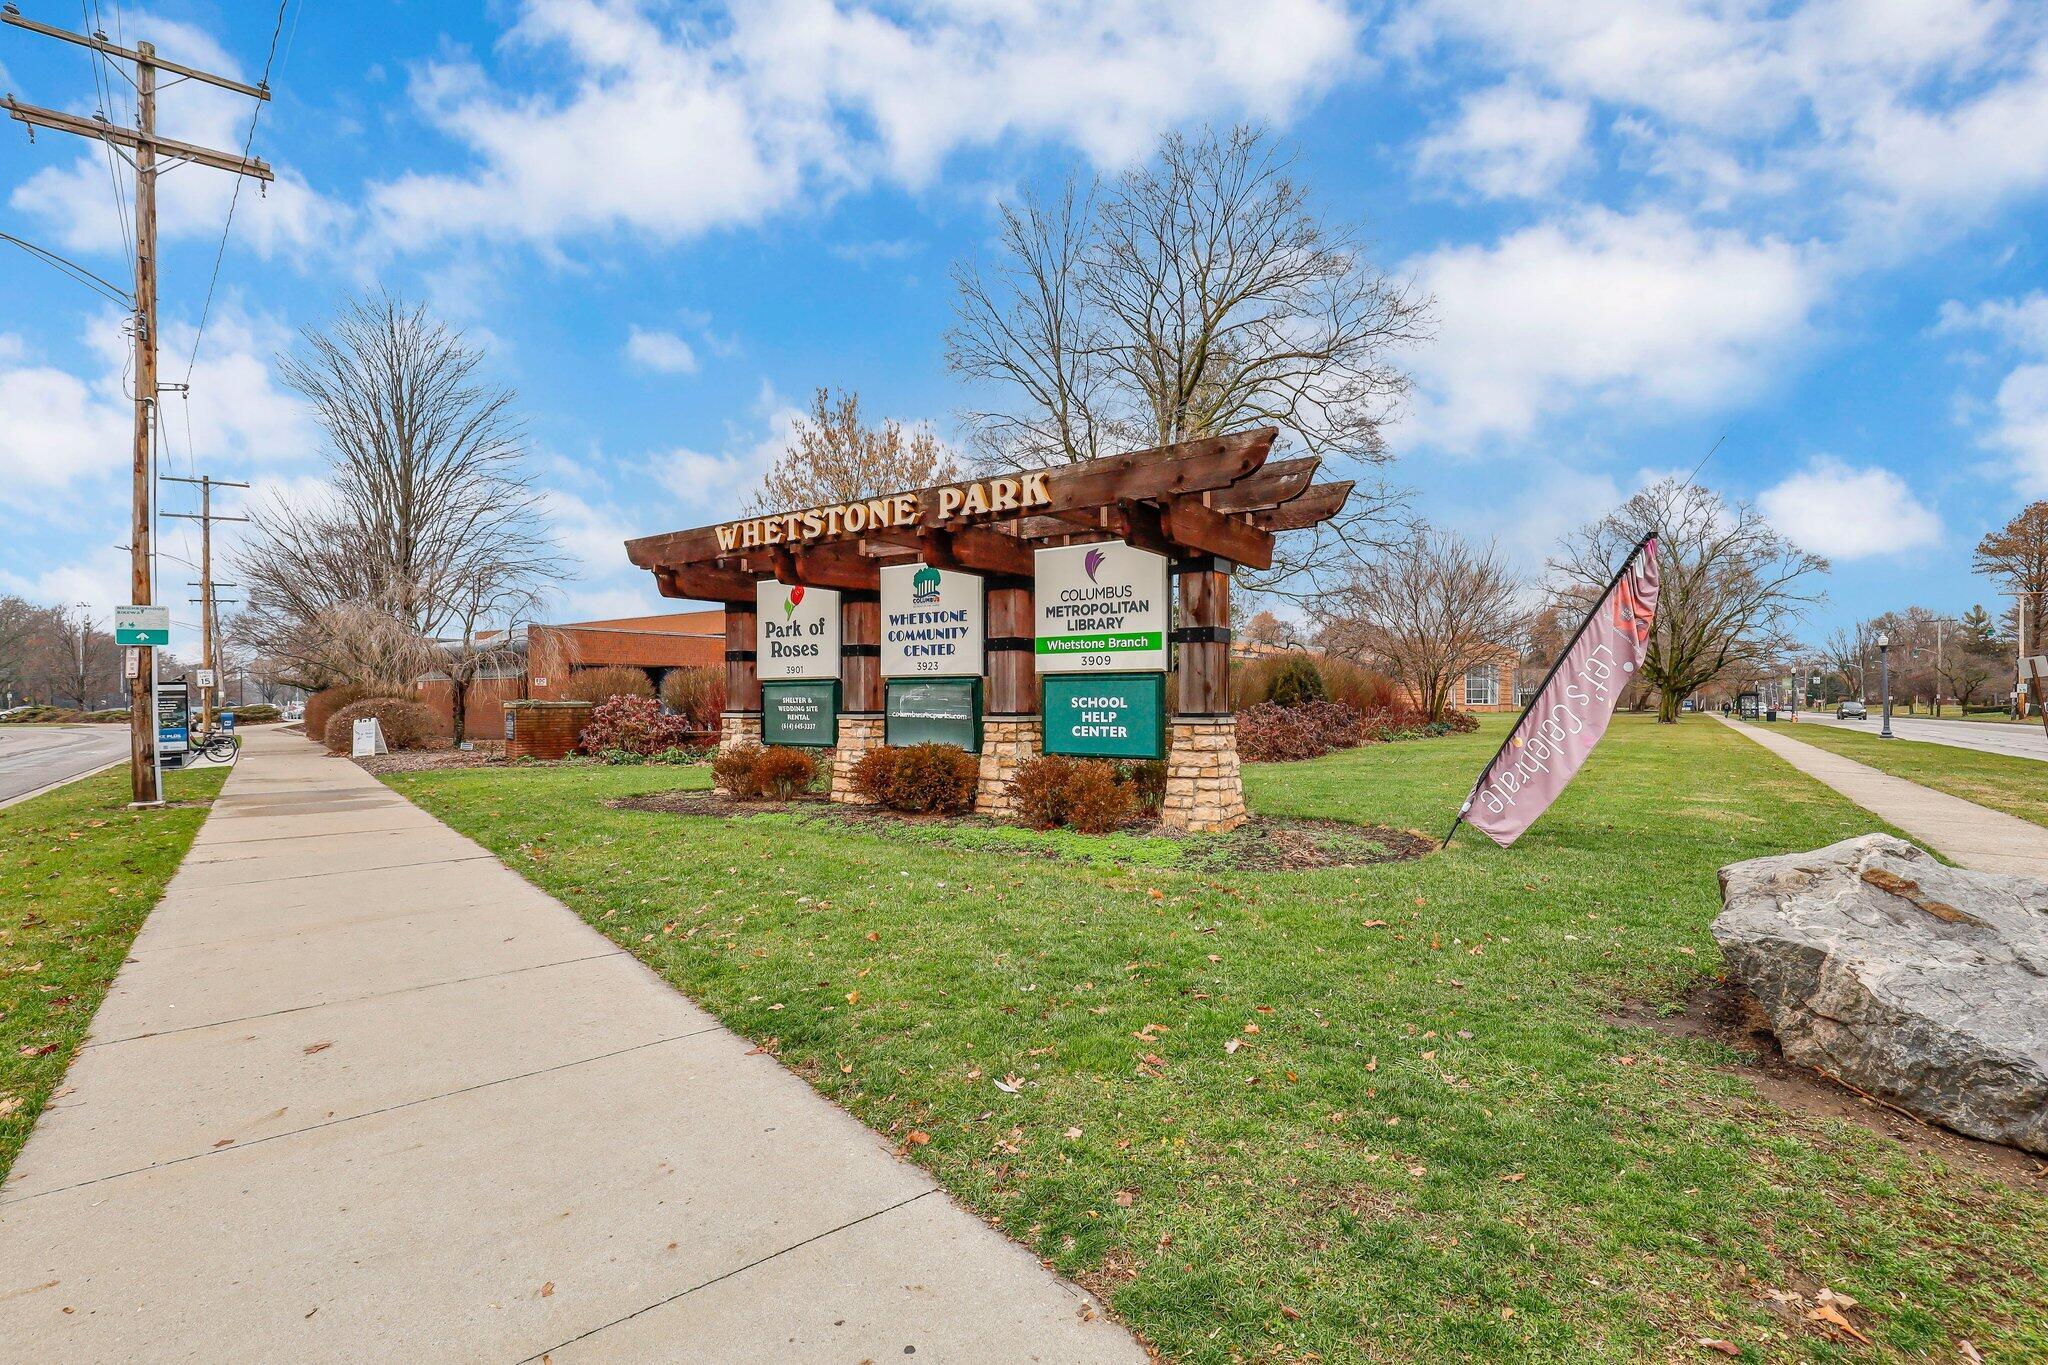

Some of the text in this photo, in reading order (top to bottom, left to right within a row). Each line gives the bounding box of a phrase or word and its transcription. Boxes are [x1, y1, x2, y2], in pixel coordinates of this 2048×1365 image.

[714, 472, 1053, 551] WHETSTONE PARK
[1060, 585, 1132, 602] COLUMBUS
[1045, 600, 1149, 618] METROPOLITAN
[888, 609, 968, 626] WHETSTONE
[1067, 616, 1124, 631] LIBRARY
[765, 617, 825, 639] Park of
[888, 627, 969, 642] COMMUNITY
[770, 641, 819, 658] Roses
[903, 644, 956, 657] CENTER
[1046, 637, 1148, 651] Whetstone Branch
[916, 661, 939, 671] 3923
[1081, 655, 1112, 667] 3909
[786, 665, 804, 674] 3901
[1071, 697, 1128, 709] SCHOOL
[1081, 711, 1117, 723] HELP
[1071, 725, 1128, 738] CENTER
[1480, 644, 1618, 814] Let's Celebrate
